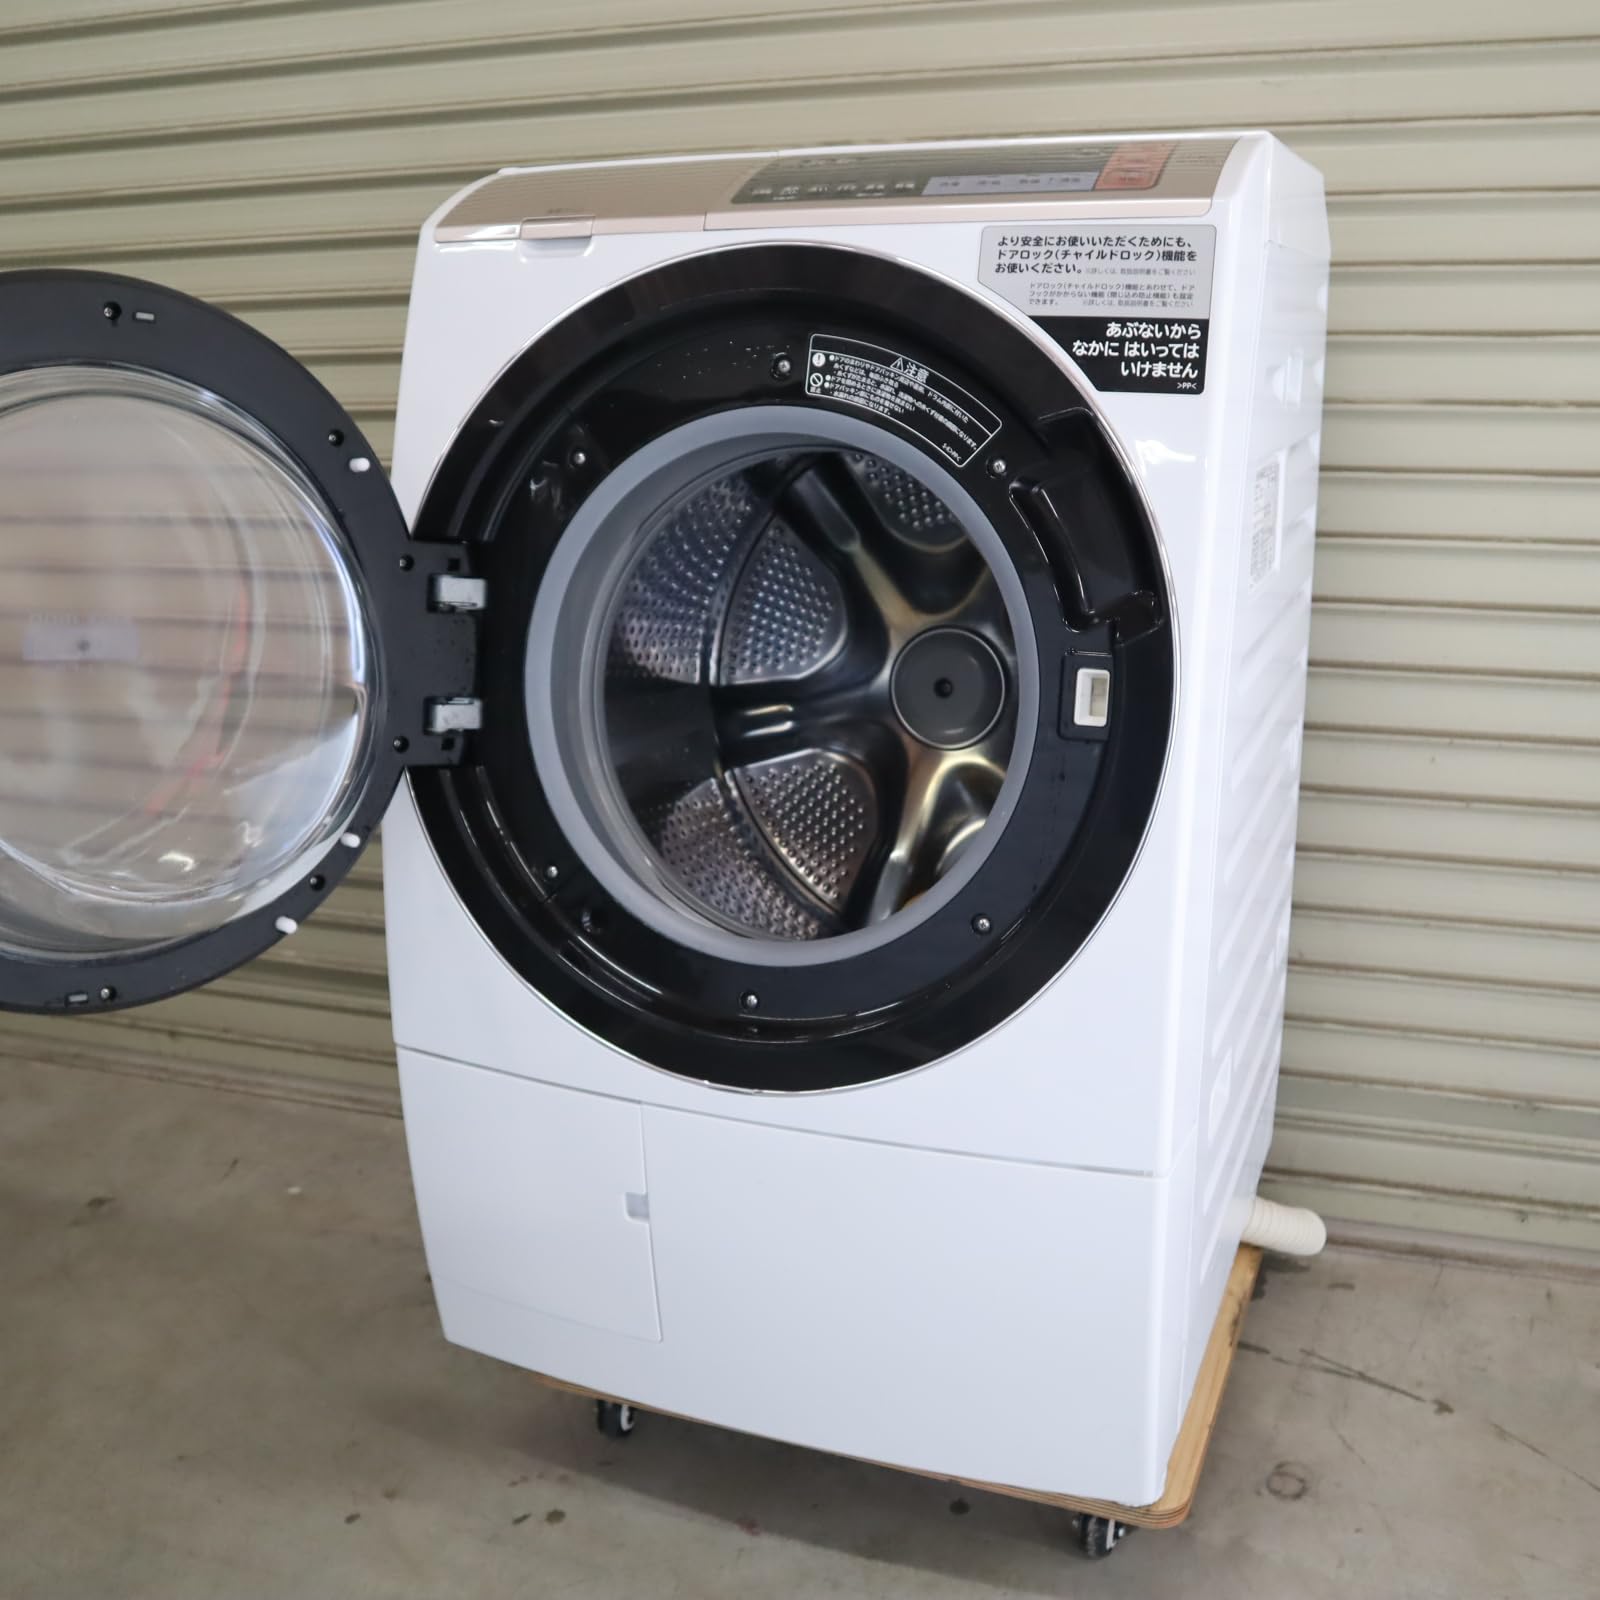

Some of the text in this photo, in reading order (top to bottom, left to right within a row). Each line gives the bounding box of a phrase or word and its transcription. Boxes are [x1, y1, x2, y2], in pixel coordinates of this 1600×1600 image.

[997, 236, 1193, 248] より安全にお使いいただくためにも、
[994, 262, 1083, 274] お使いください。
[1105, 322, 1202, 340] あぶないから
[1072, 340, 1200, 358] なかに はいっては
[904, 362, 929, 383] 注意
[1121, 361, 1198, 379] いけません
